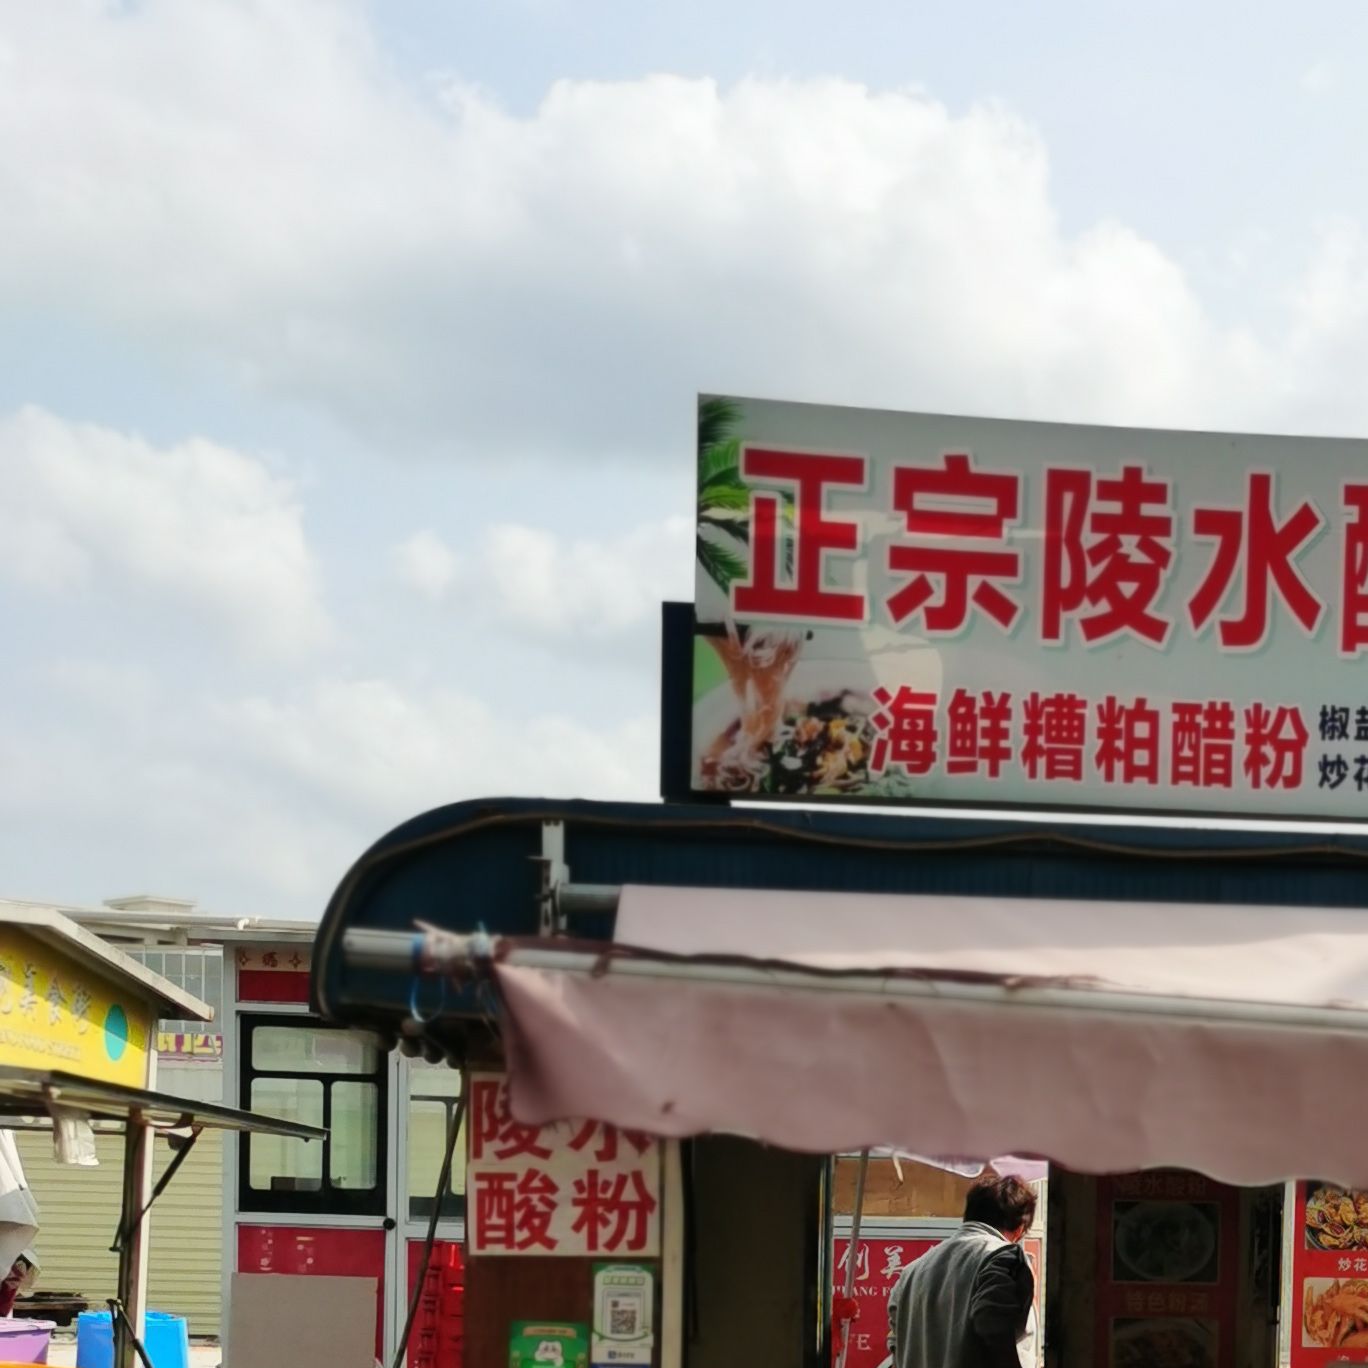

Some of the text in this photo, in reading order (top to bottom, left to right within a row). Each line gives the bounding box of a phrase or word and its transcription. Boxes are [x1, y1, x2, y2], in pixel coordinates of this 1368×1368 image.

[870, 684, 1310, 791] 海鲜糟粕醋粉
[474, 1167, 656, 1252] 酸粉
